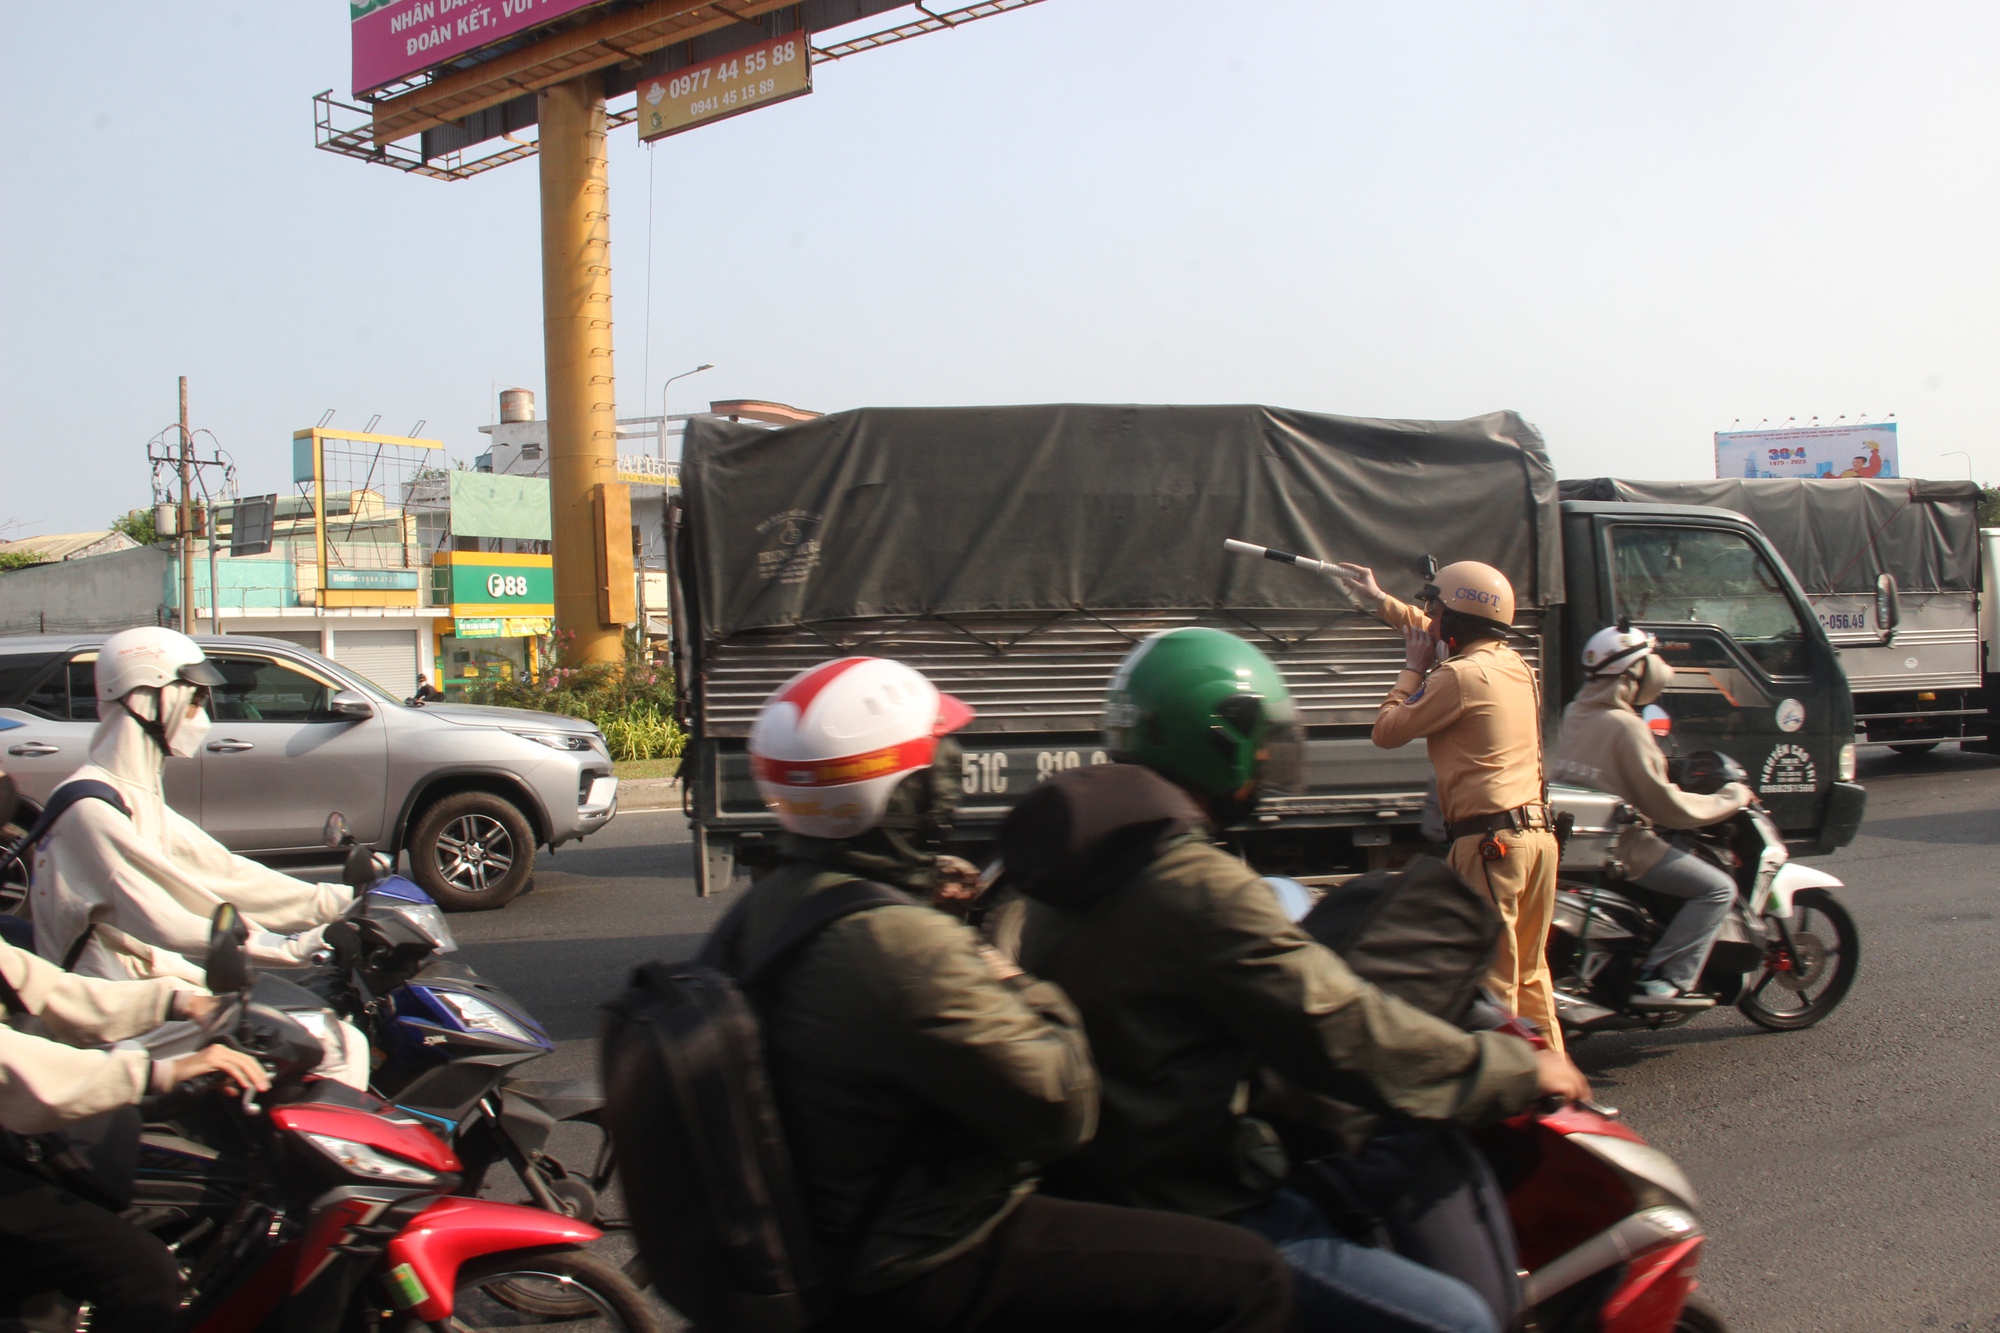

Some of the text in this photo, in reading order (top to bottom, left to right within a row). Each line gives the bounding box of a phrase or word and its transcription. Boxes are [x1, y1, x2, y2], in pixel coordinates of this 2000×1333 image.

[391, 2, 434, 34] NHÂN
[406, 23, 451, 56] ĐOÀN
[457, 4, 497, 36] KẾT,
[669, 41, 796, 99] 0977 44 55 88
[690, 78, 775, 115] 0941 45 15 89
[487, 573, 527, 597] F88
[1455, 587, 1500, 607] CSGT
[962, 752, 1008, 794] 51C
